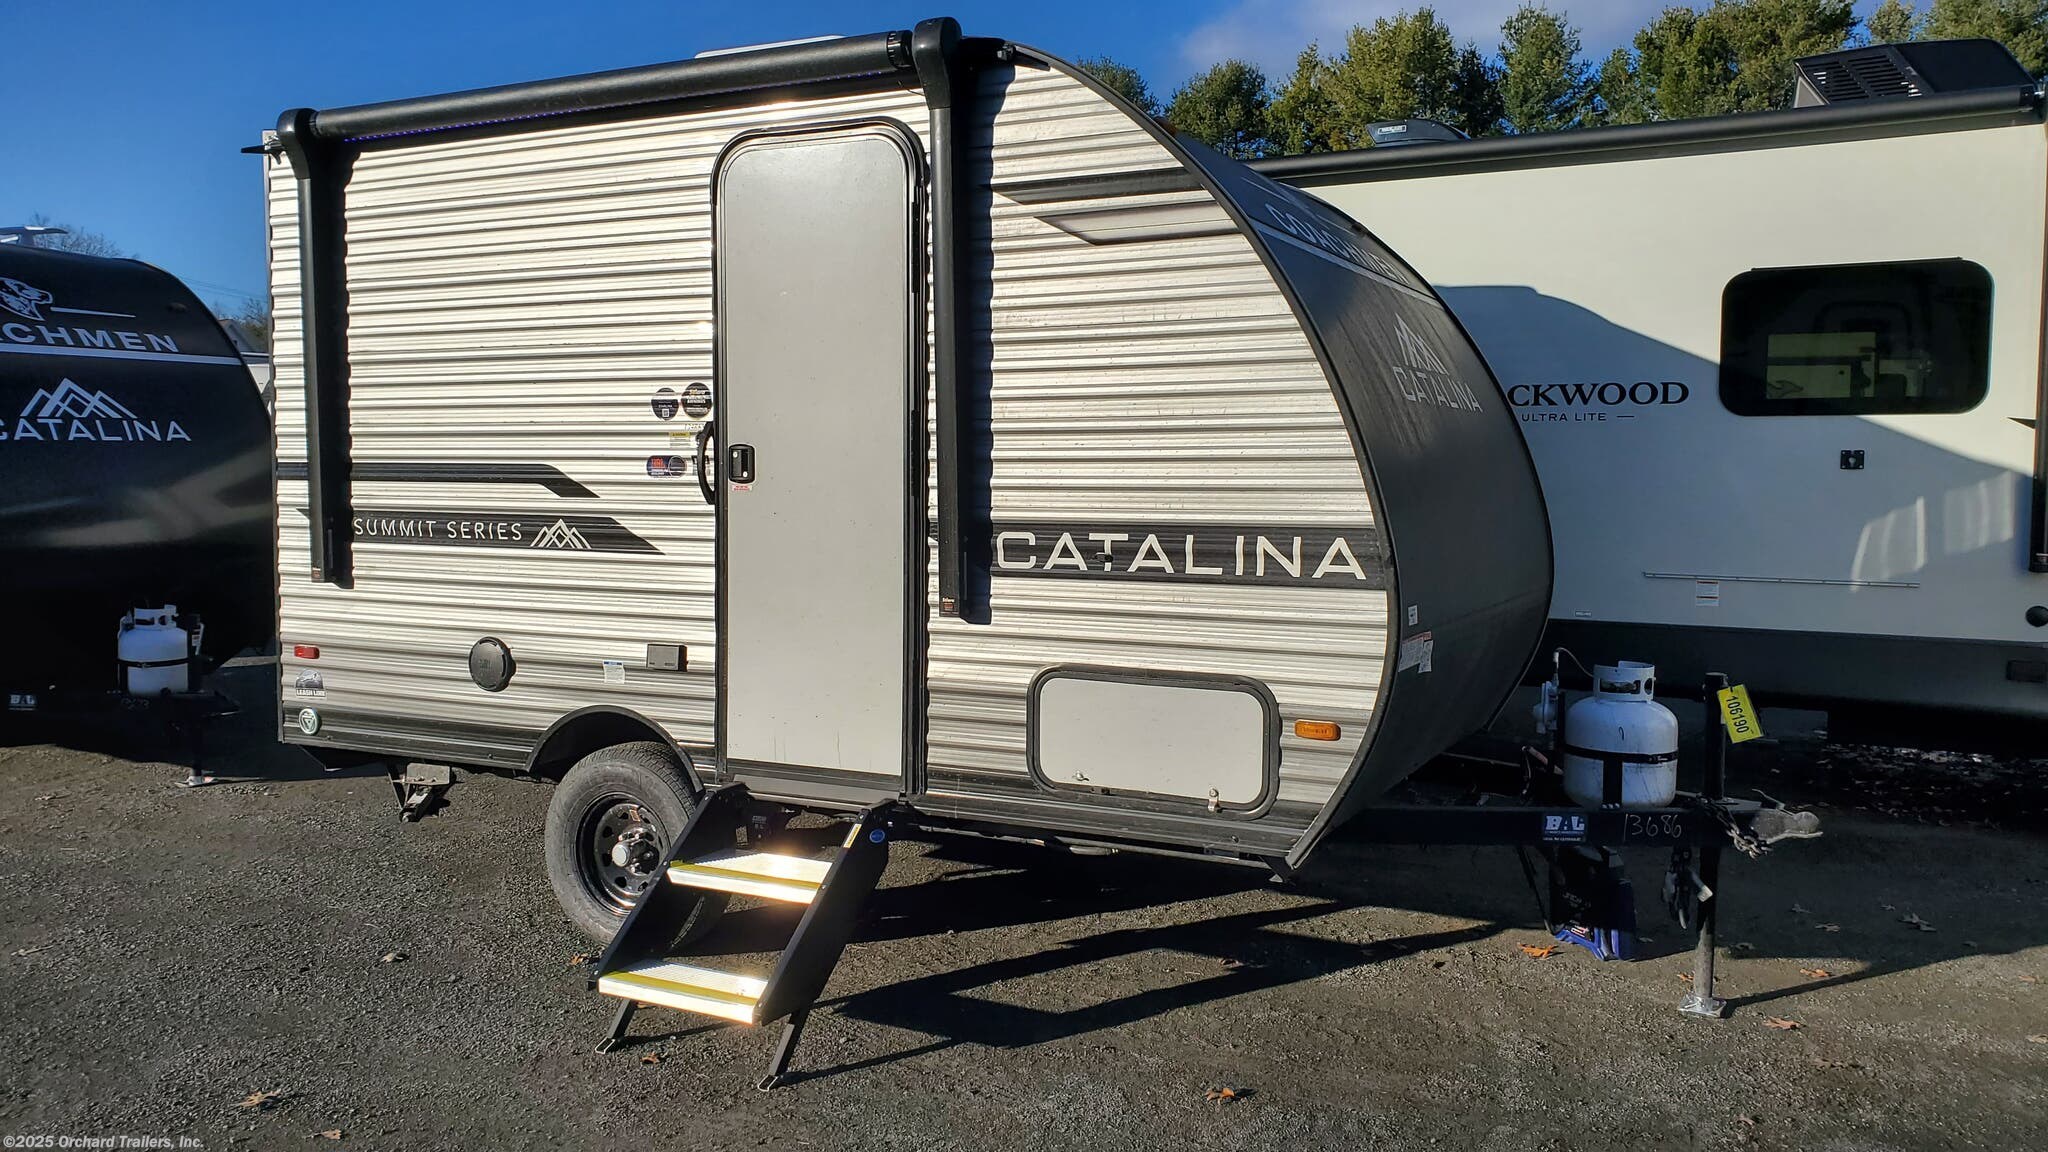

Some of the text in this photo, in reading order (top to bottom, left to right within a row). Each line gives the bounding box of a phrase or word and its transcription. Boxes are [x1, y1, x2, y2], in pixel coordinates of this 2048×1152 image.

[1264, 203, 1410, 285] COACHMEN
[0, 323, 179, 352] CHMEN
[1392, 366, 1483, 413] CATALINA
[1507, 381, 1690, 407] CKWOOD
[0, 417, 192, 441] ATALINA
[1521, 412, 1607, 422] ULTRA LITE
[353, 518, 523, 542] SUMMIT SERIES
[996, 531, 1368, 580] CATALINA
[1726, 695, 1750, 733] 106190
[1623, 813, 1682, 841] 13686
